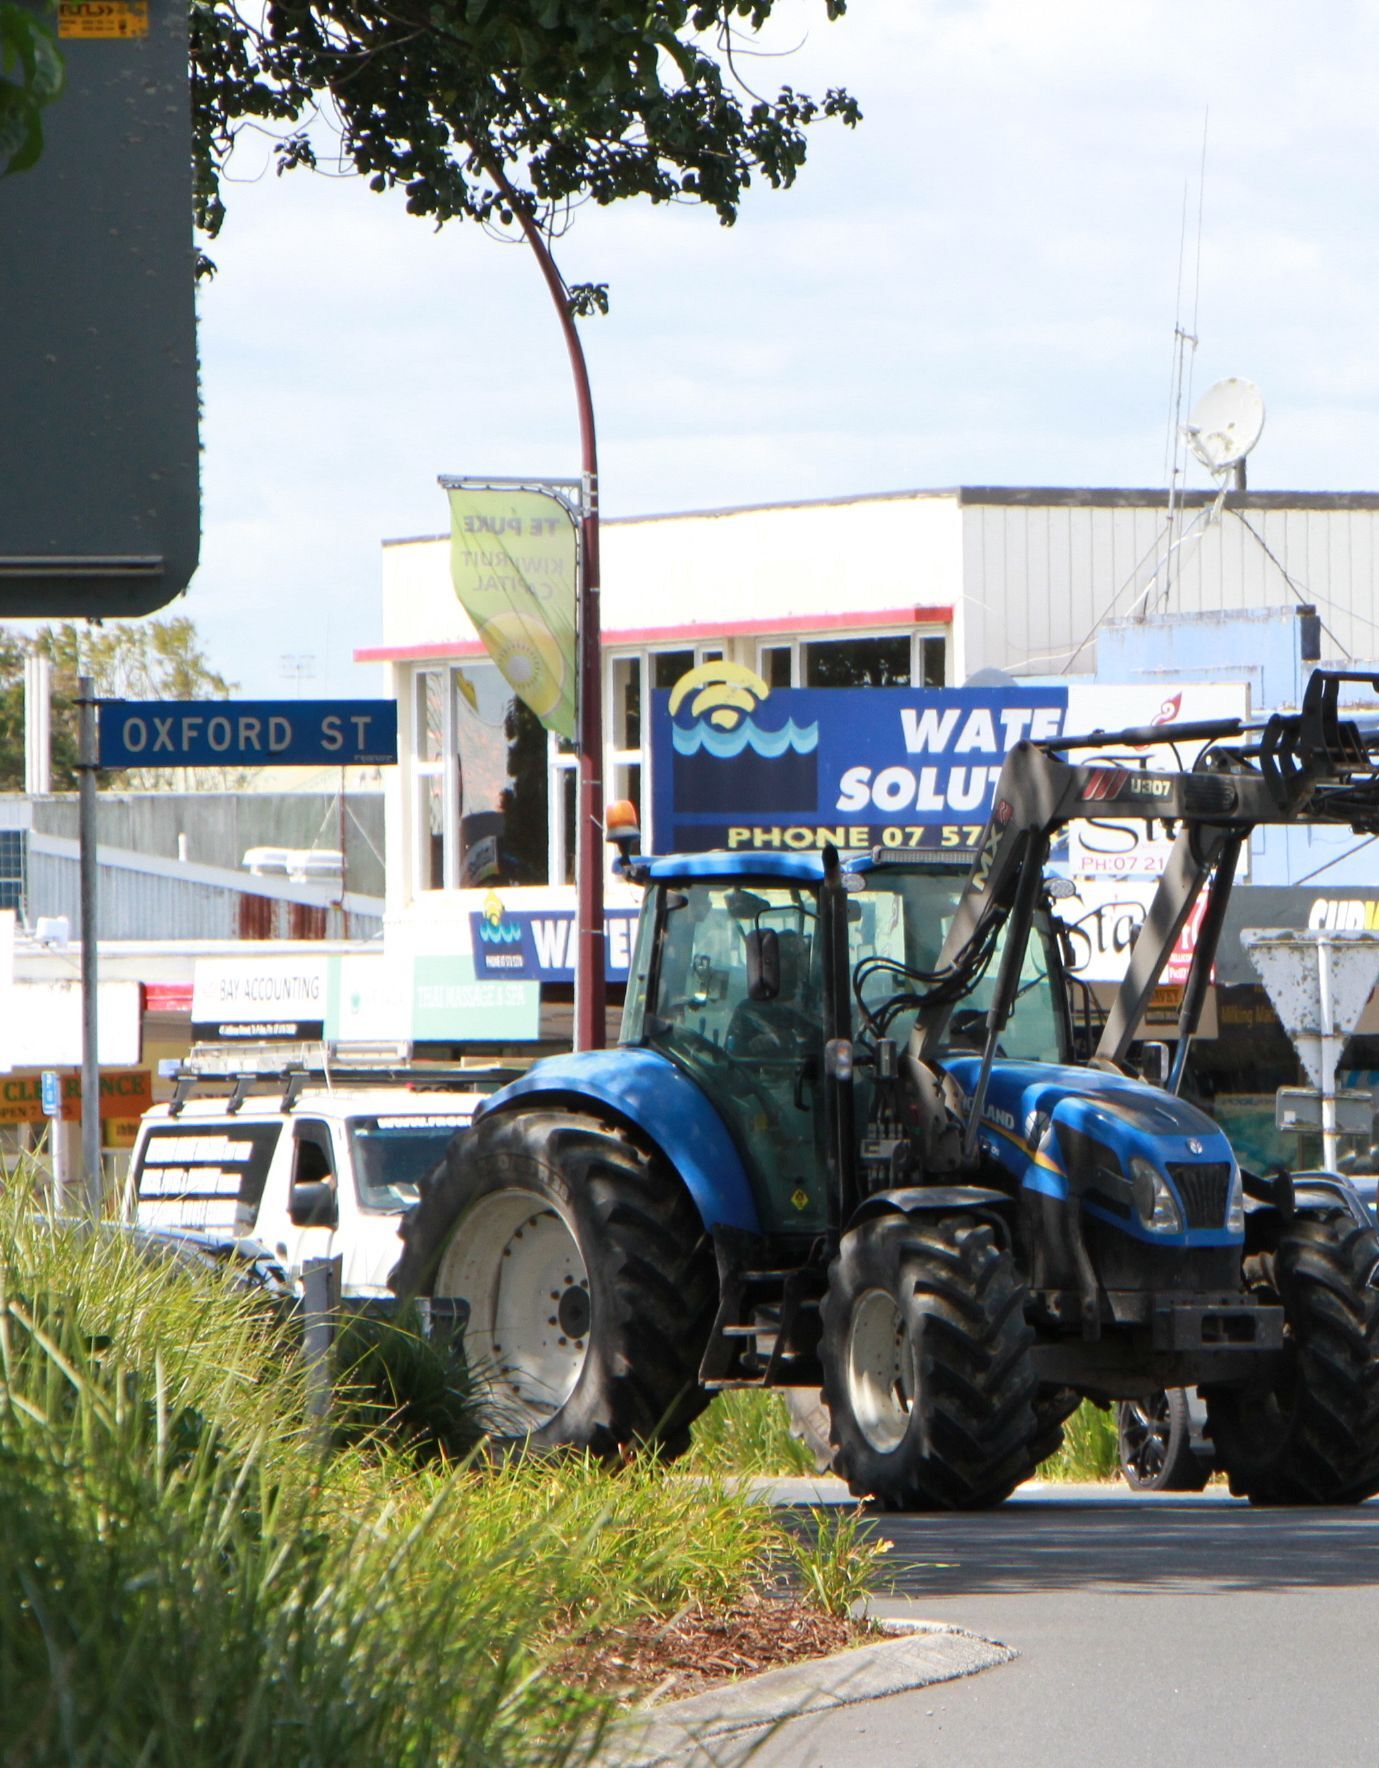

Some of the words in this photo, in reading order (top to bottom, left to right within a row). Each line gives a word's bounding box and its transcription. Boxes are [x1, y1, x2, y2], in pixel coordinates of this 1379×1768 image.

[122, 716, 293, 752] OXFORD
[320, 715, 372, 751] ST
[1130, 777, 1171, 796] U307
[728, 826, 870, 849] PHONE
[882, 827, 926, 848] 07
[218, 978, 240, 1001] BAY
[243, 975, 320, 1001] ACCOUNTING
[3, 1074, 146, 1101] CLERNCE
